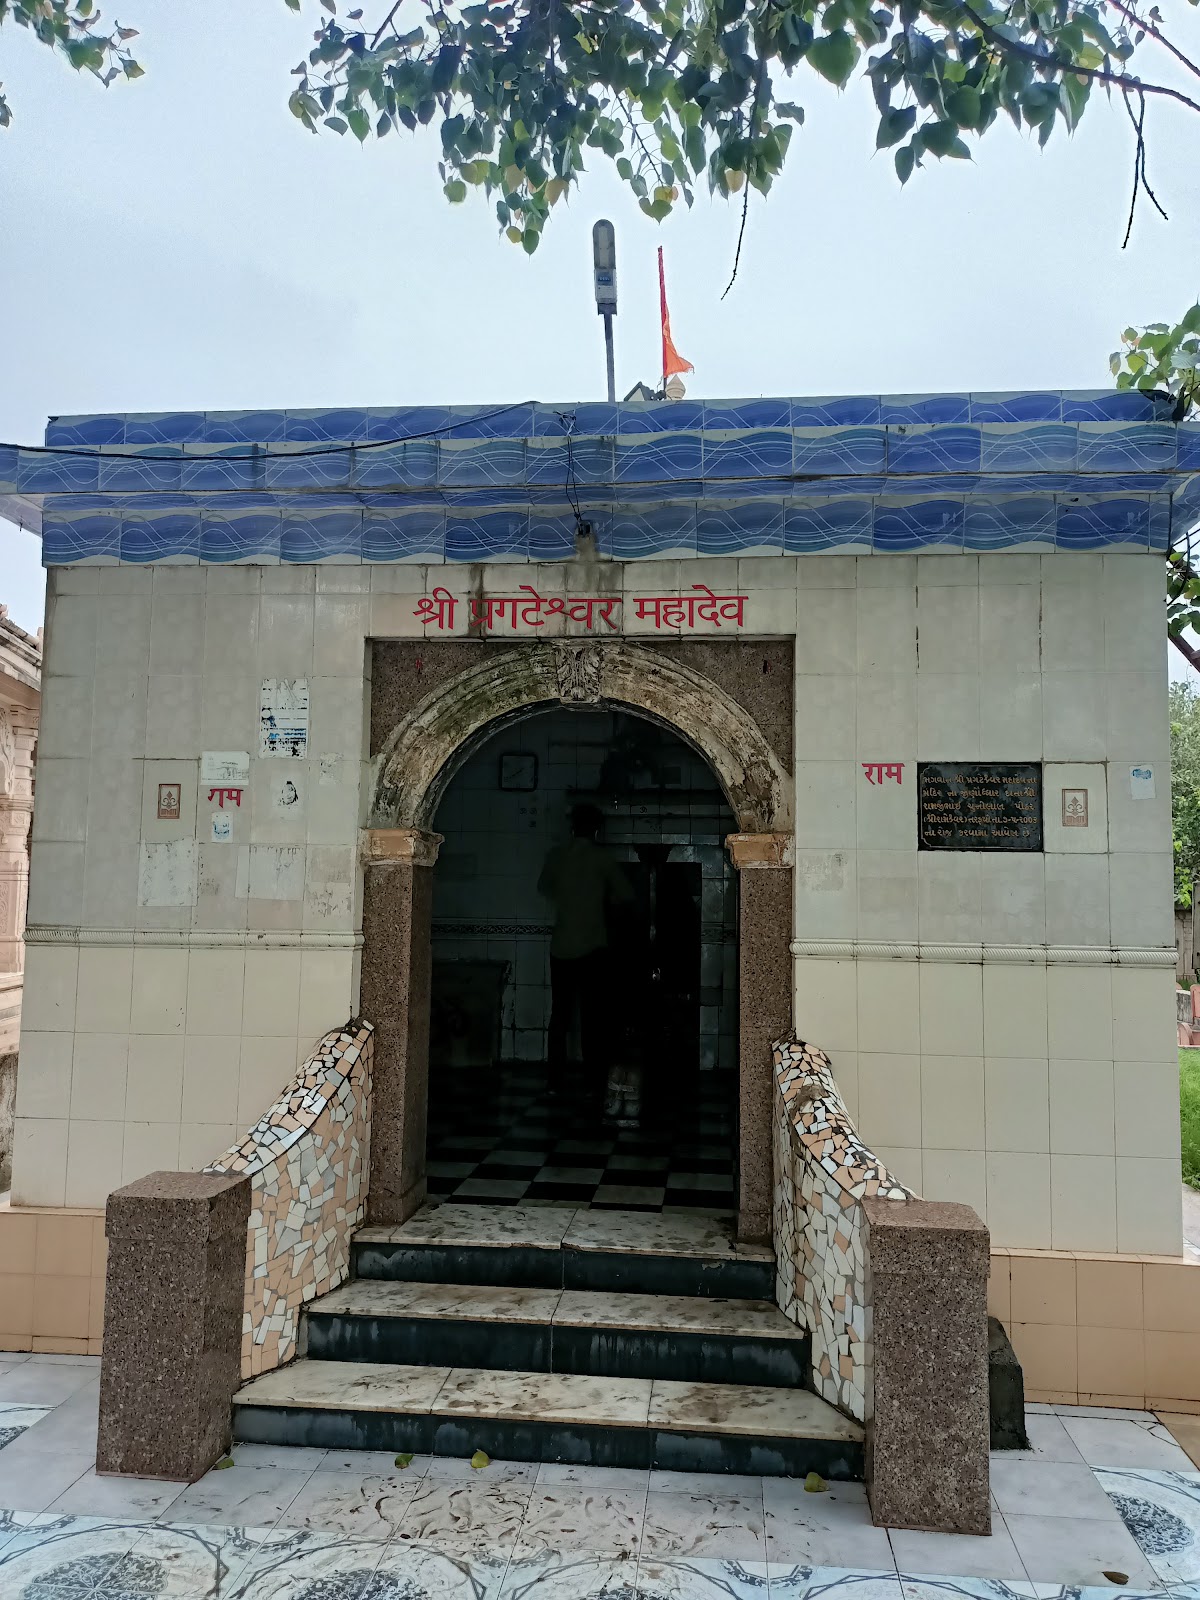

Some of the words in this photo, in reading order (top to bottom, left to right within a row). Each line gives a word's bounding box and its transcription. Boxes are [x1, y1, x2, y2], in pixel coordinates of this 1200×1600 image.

[413, 587, 458, 630] श्री
[469, 585, 622, 630] प्रगटेश्वर
[633, 584, 749, 629] महादेव
[861, 762, 906, 785] राम
